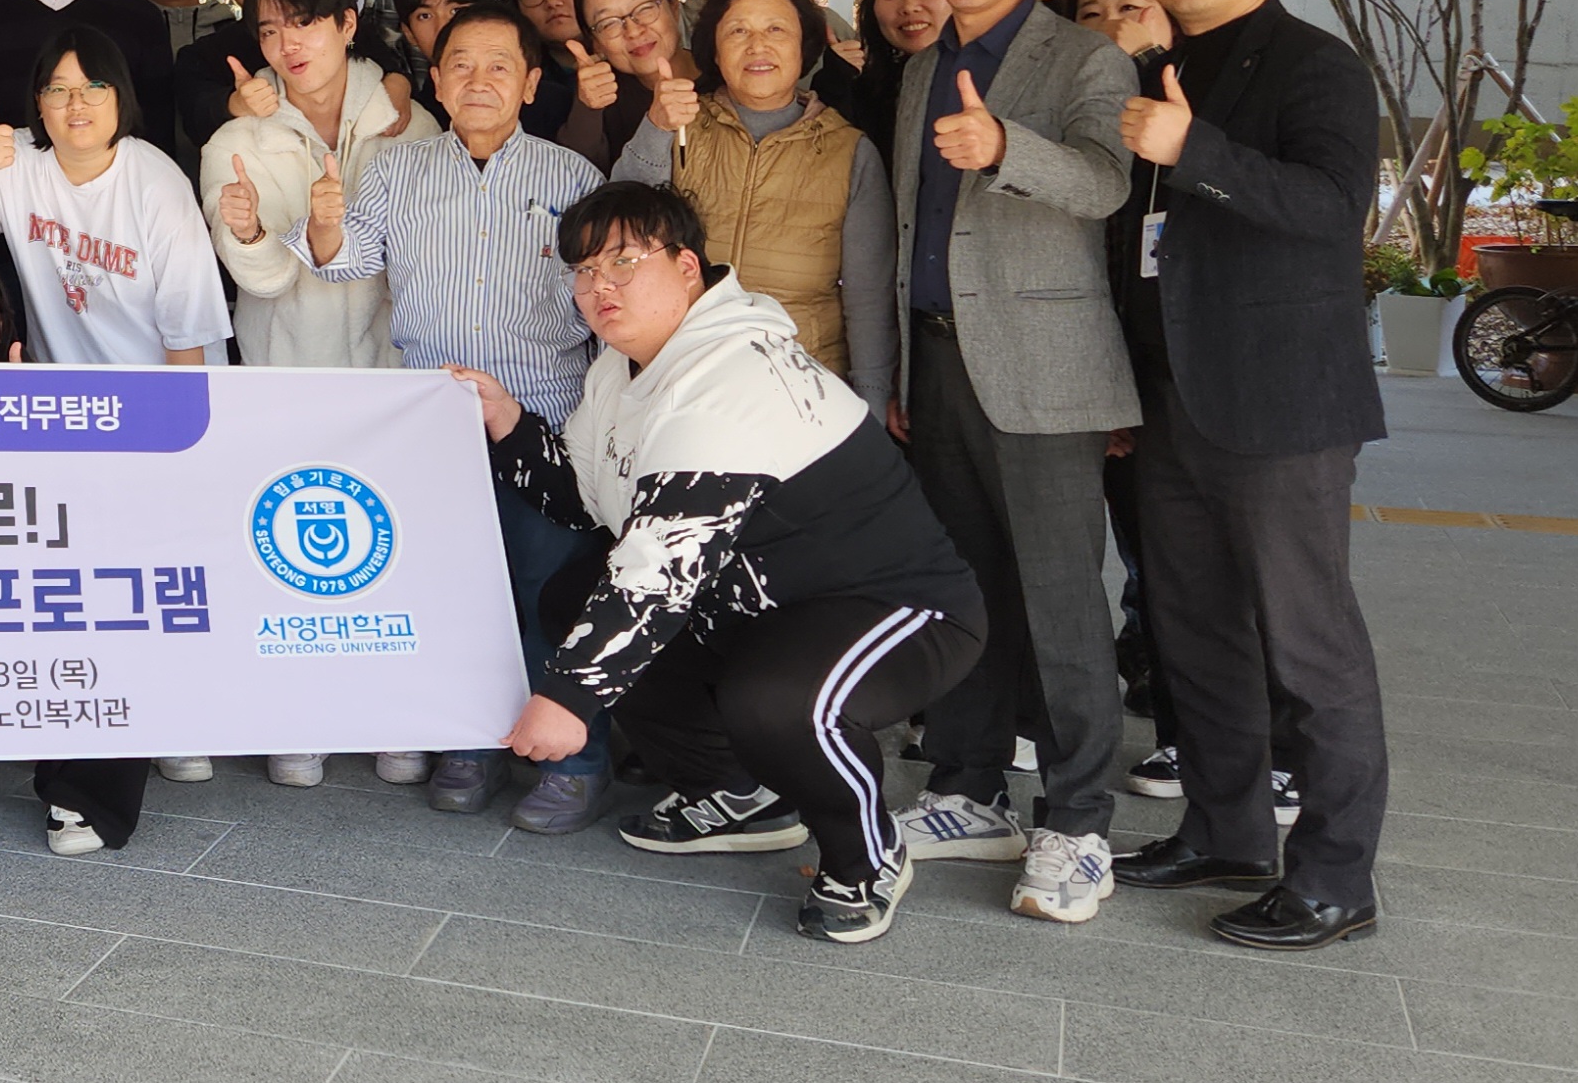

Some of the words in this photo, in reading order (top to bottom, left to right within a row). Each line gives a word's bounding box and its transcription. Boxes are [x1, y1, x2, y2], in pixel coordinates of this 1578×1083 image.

[27, 213, 71, 256] NTE
[77, 232, 139, 281] DAME
[302, 502, 336, 514] 서영
[255, 529, 307, 587] SEOYEONG
[312, 578, 347, 593] 1978
[348, 528, 391, 588] UNIVERSITY
[257, 614, 415, 641] 서영대학교
[259, 643, 337, 654] SEOYEONG
[341, 641, 417, 653] UNIVERSITY
[49, 657, 98, 691] (목)
